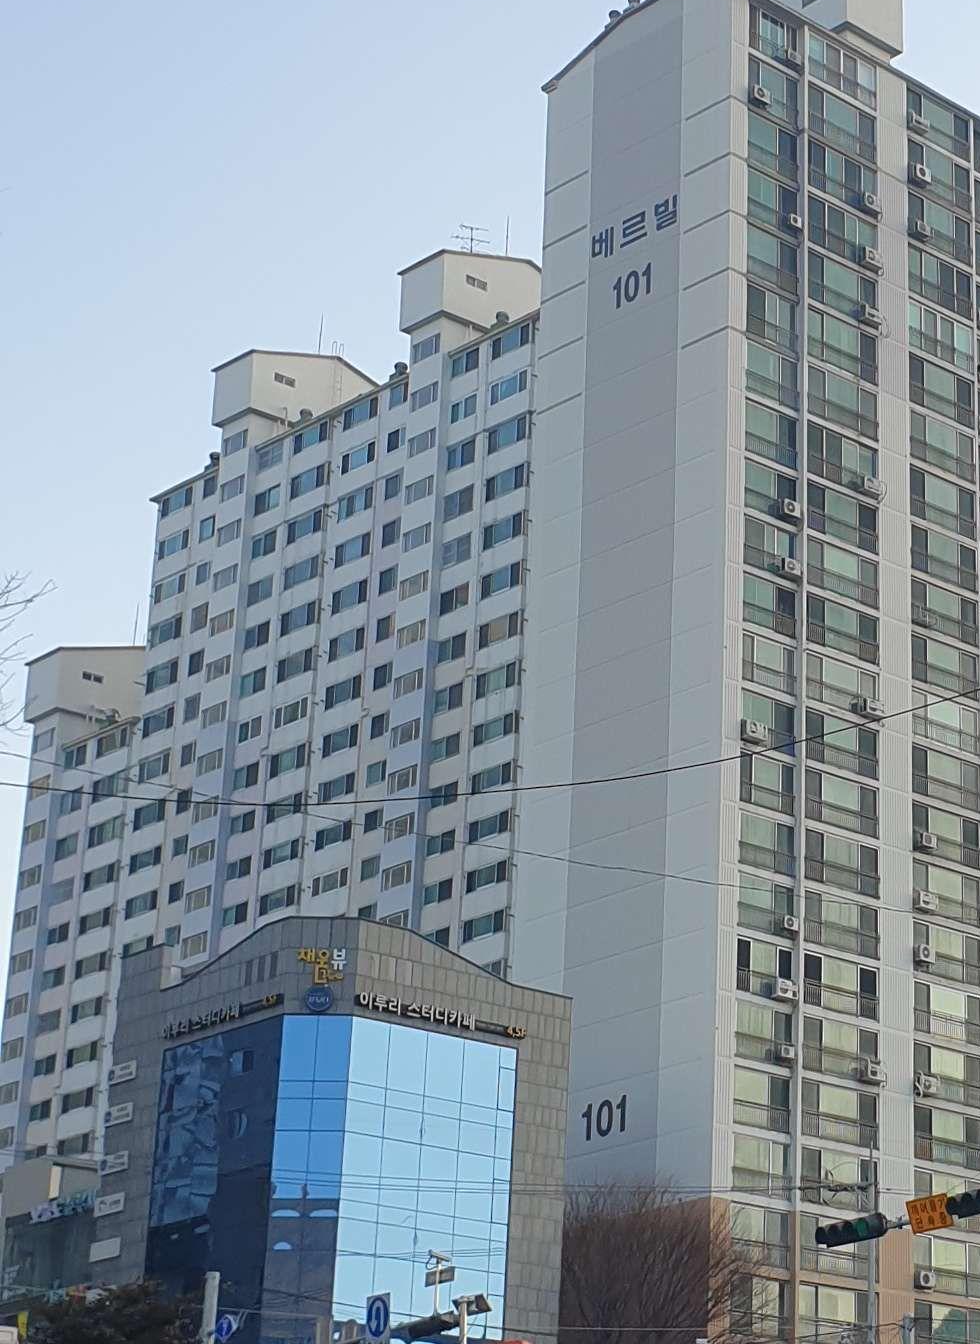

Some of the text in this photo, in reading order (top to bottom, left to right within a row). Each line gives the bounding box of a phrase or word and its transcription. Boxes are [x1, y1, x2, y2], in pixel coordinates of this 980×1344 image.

[591, 194, 678, 258] 베르빌
[612, 262, 652, 309] 101
[360, 991, 401, 1016] 이루리
[406, 1001, 476, 1032] 스터디카페
[581, 1094, 627, 1141] 101
